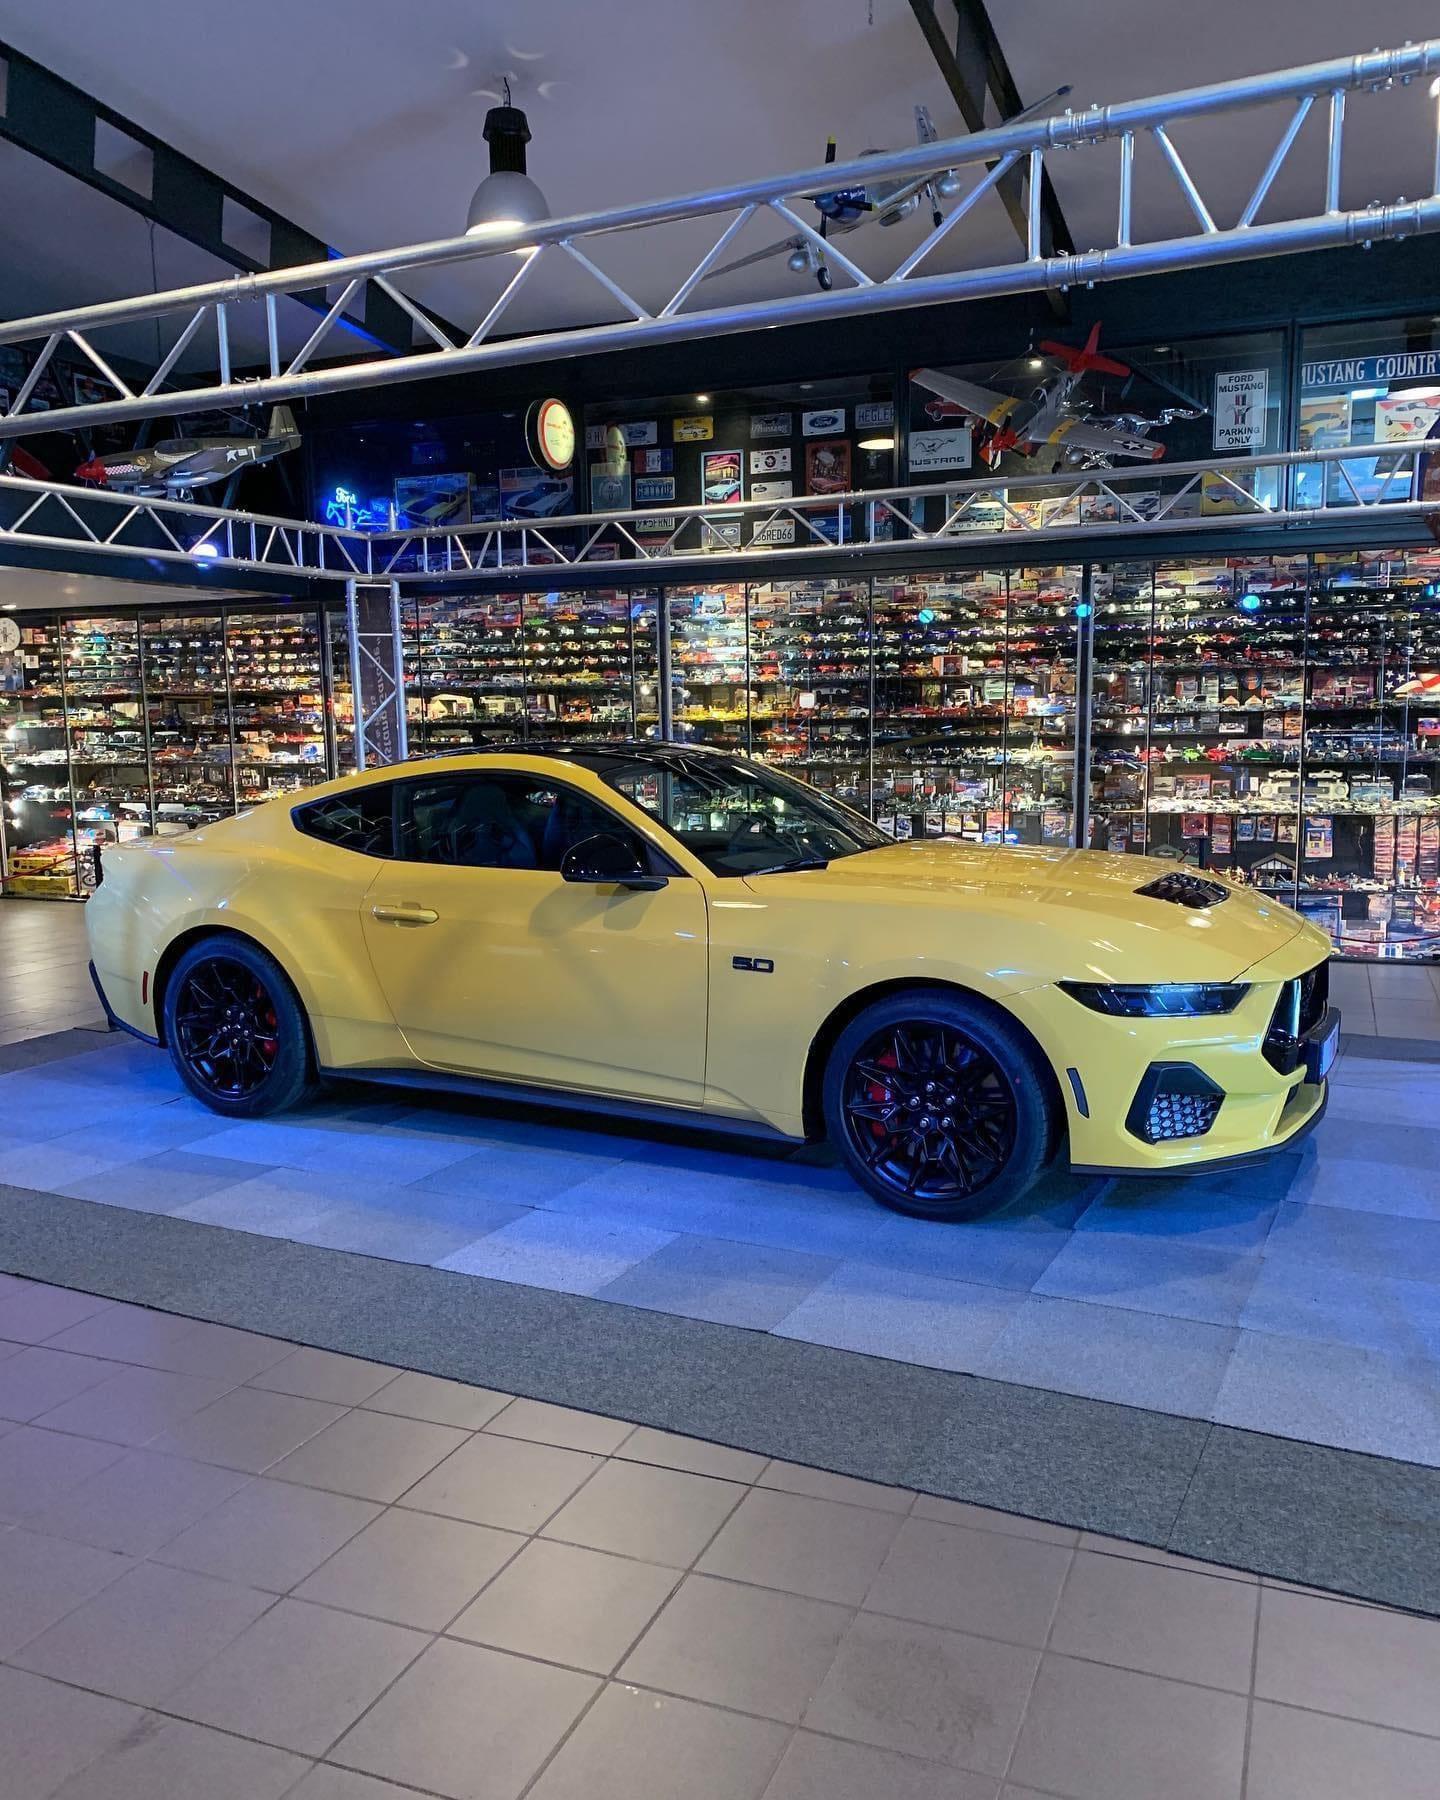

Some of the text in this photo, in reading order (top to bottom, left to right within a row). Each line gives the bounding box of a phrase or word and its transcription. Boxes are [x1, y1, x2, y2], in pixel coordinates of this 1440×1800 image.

[1229, 374, 1254, 383] FORD
[1219, 383, 1264, 393] MUSTANG
[1219, 427, 1260, 436] PARKING
[1228, 436, 1251, 445] ONLY
[336, 487, 357, 504] Ford
[732, 955, 774, 973] 5.0
